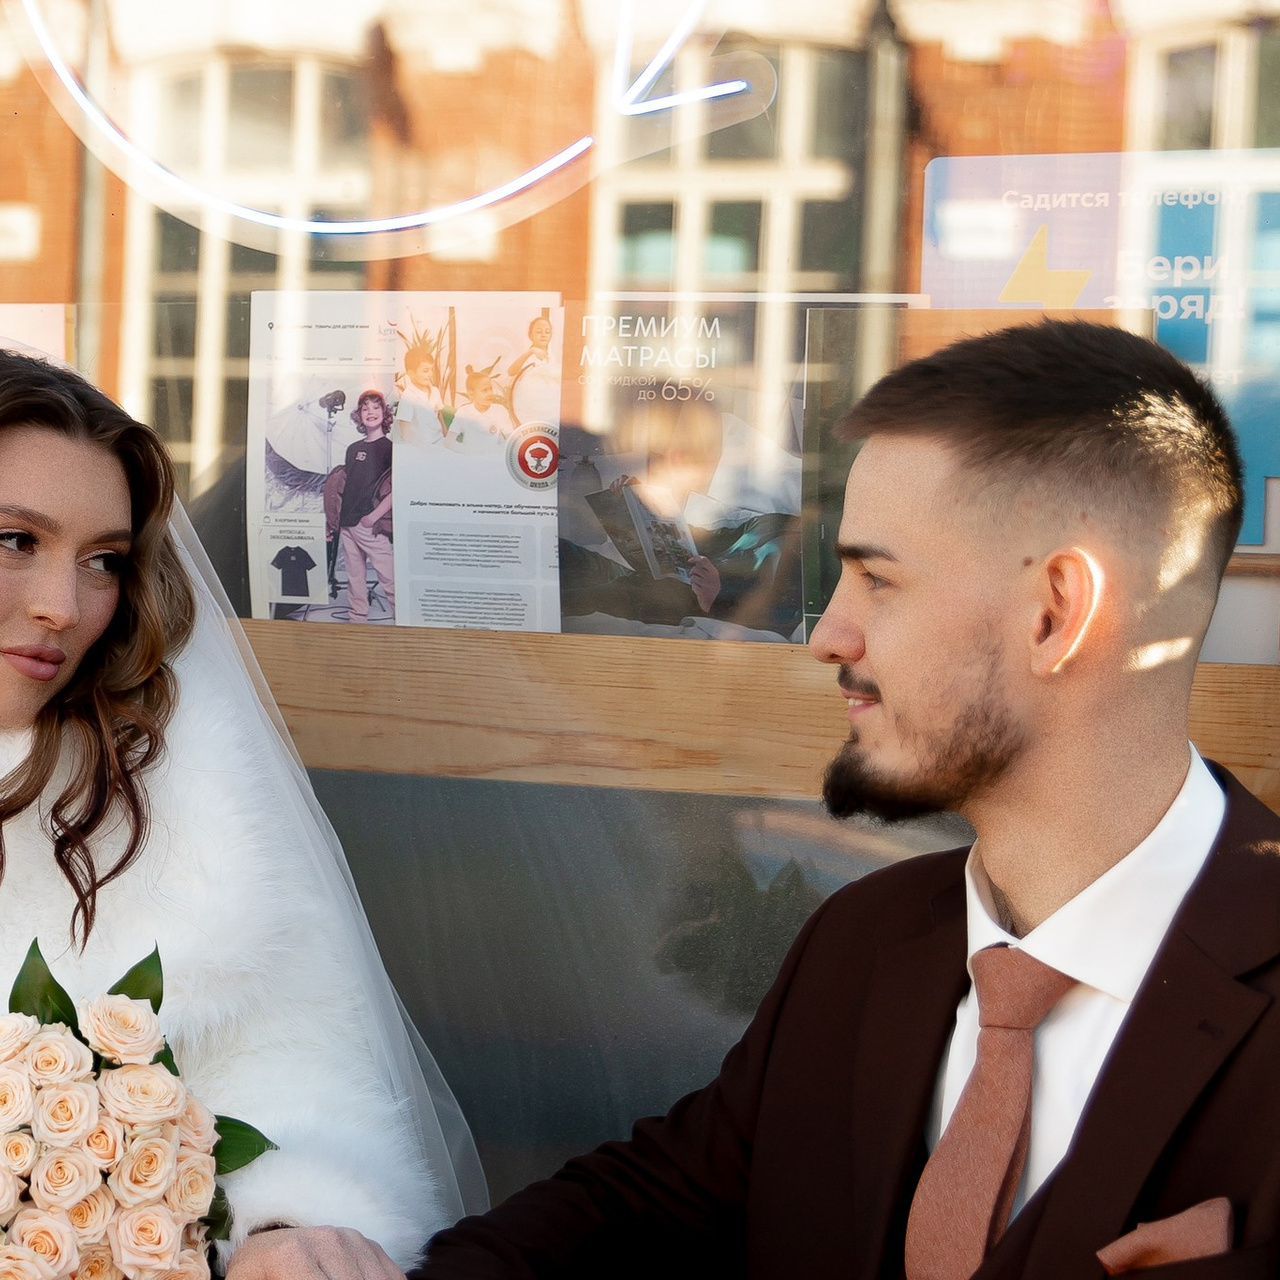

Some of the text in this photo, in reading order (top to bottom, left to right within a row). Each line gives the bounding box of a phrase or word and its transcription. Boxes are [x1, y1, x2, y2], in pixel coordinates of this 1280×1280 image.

[1001, 189, 1109, 212] Садится
[1116, 250, 1229, 287] Бери
[581, 316, 721, 338] ПРЕМИУМ
[580, 345, 716, 369] МАТРАСЫ
[598, 374, 657, 387] КИДКОЙ
[660, 376, 716, 402] 65%
